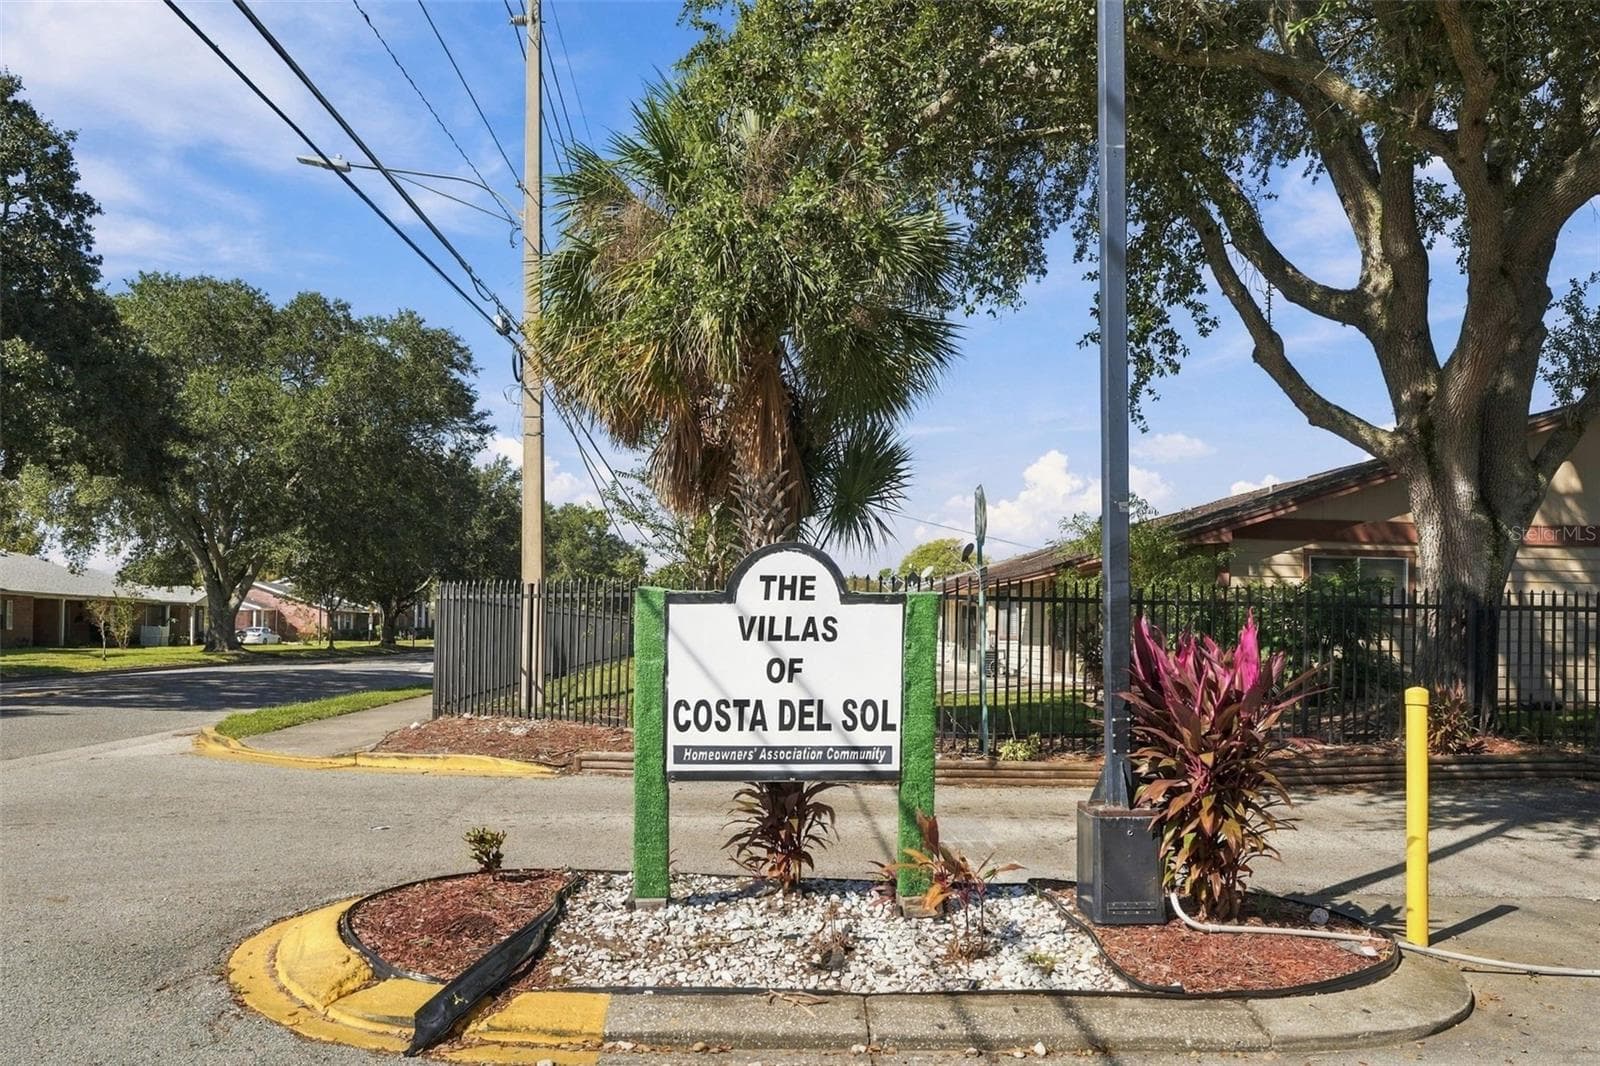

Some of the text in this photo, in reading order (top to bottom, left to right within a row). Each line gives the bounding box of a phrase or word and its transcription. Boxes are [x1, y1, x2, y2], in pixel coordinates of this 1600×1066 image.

[760, 575, 816, 600] THE
[738, 616, 838, 642] VILLAS
[766, 658, 803, 683] OF
[673, 699, 896, 732] COSTA DEL SOL
[683, 746, 886, 763] Homeowners' Association Community
